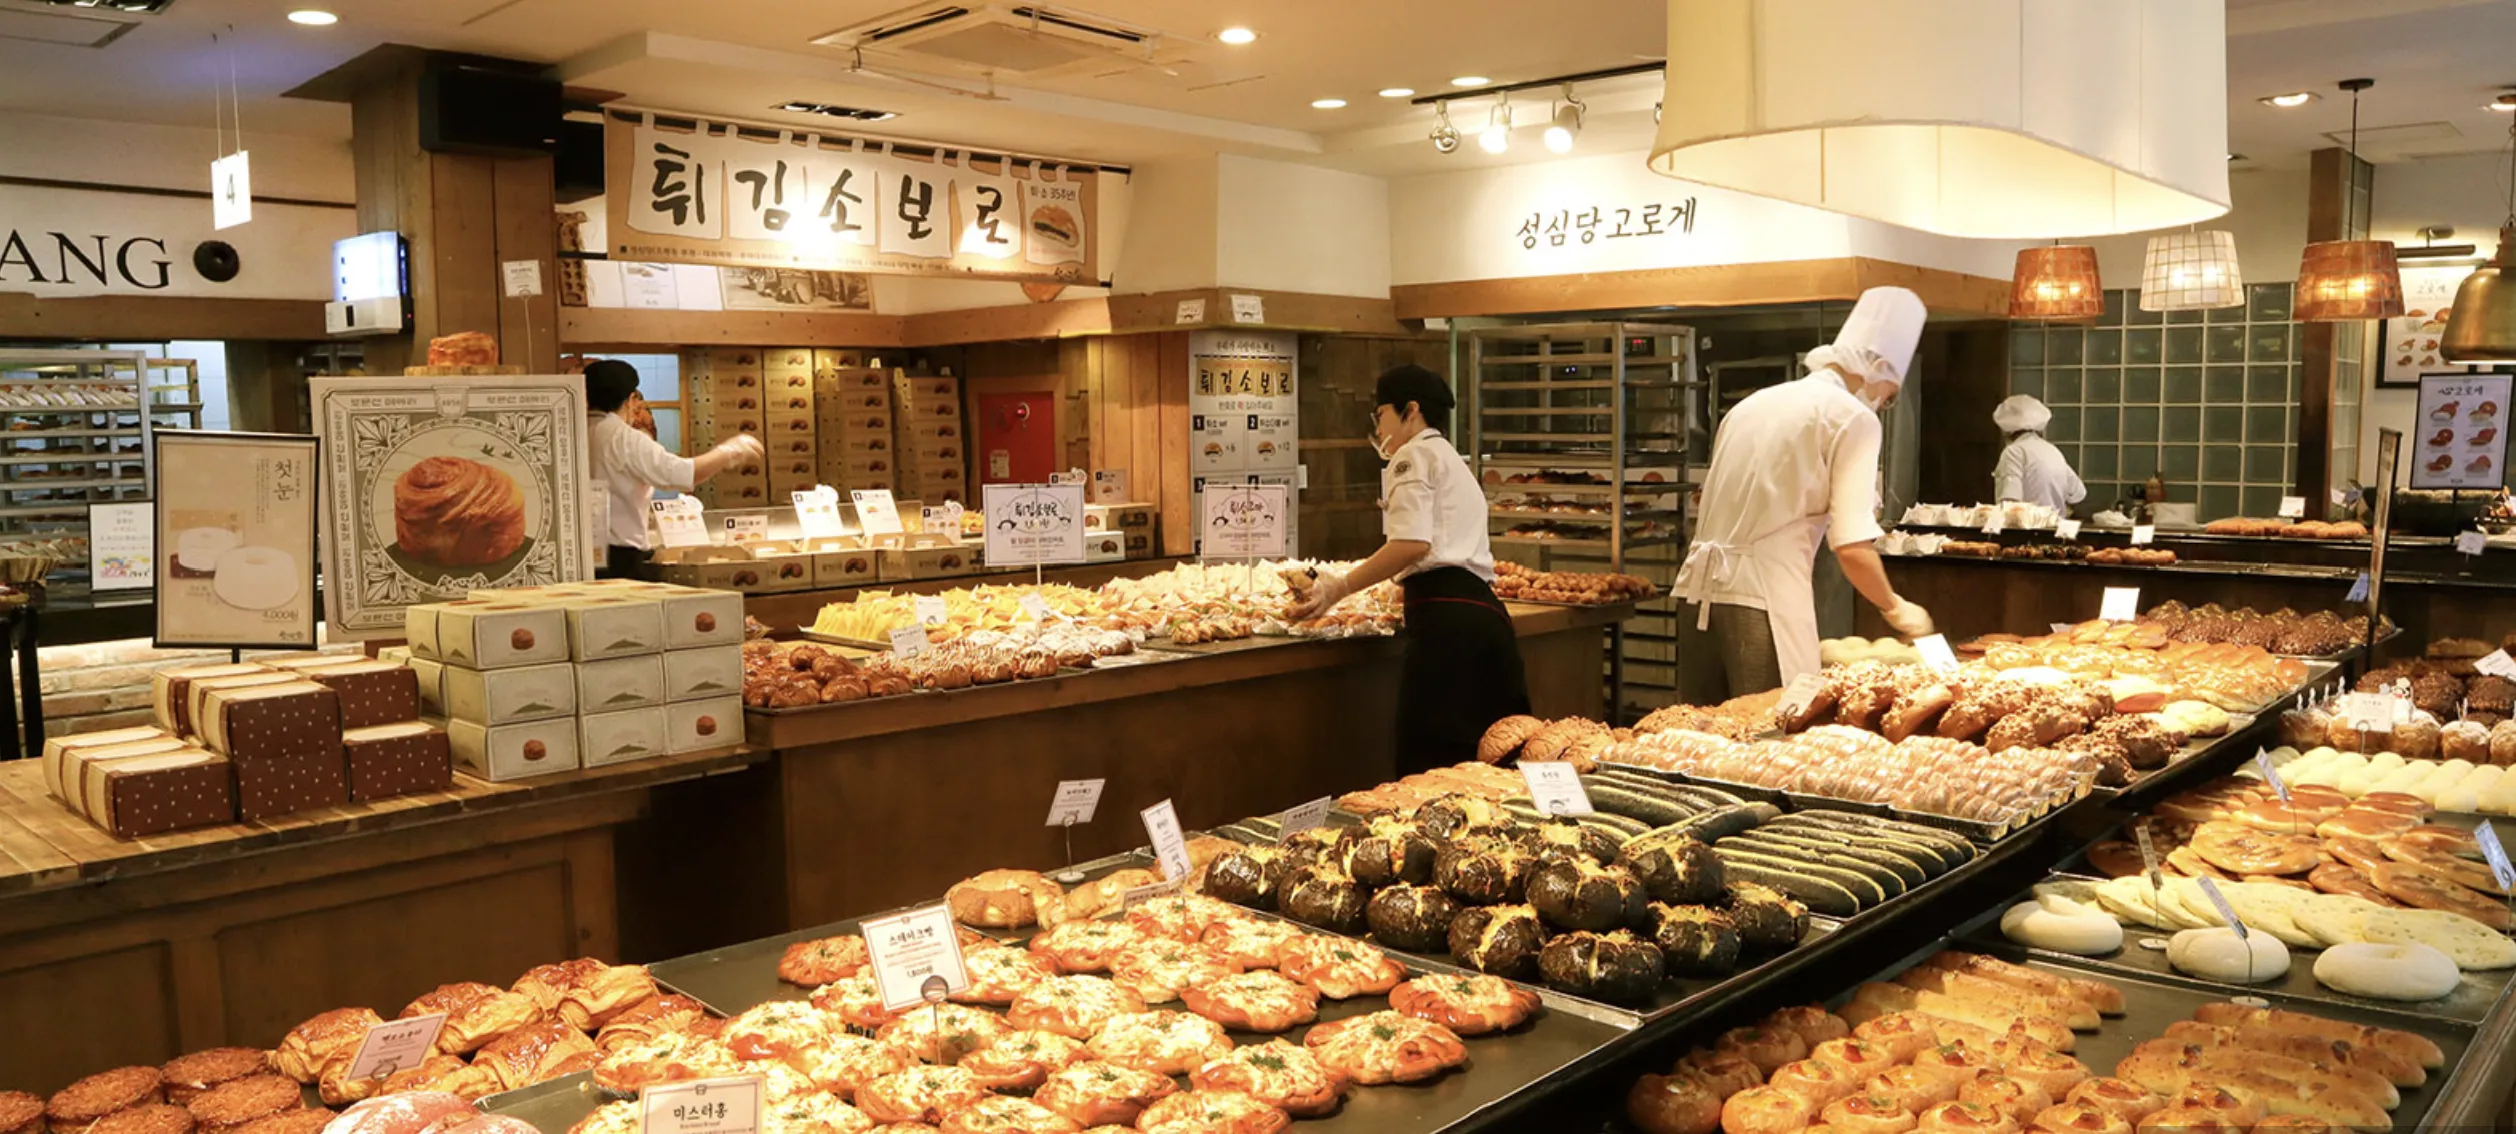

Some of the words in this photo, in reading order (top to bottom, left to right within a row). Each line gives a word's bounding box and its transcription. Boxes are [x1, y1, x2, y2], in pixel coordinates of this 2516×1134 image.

[226, 173, 235, 205] 4
[652, 142, 1008, 245] 튀김소보로
[1201, 369, 1290, 394] 튀김소보로
[890, 925, 934, 946] 스테이크빵
[673, 1101, 728, 1121] 미스터홍
